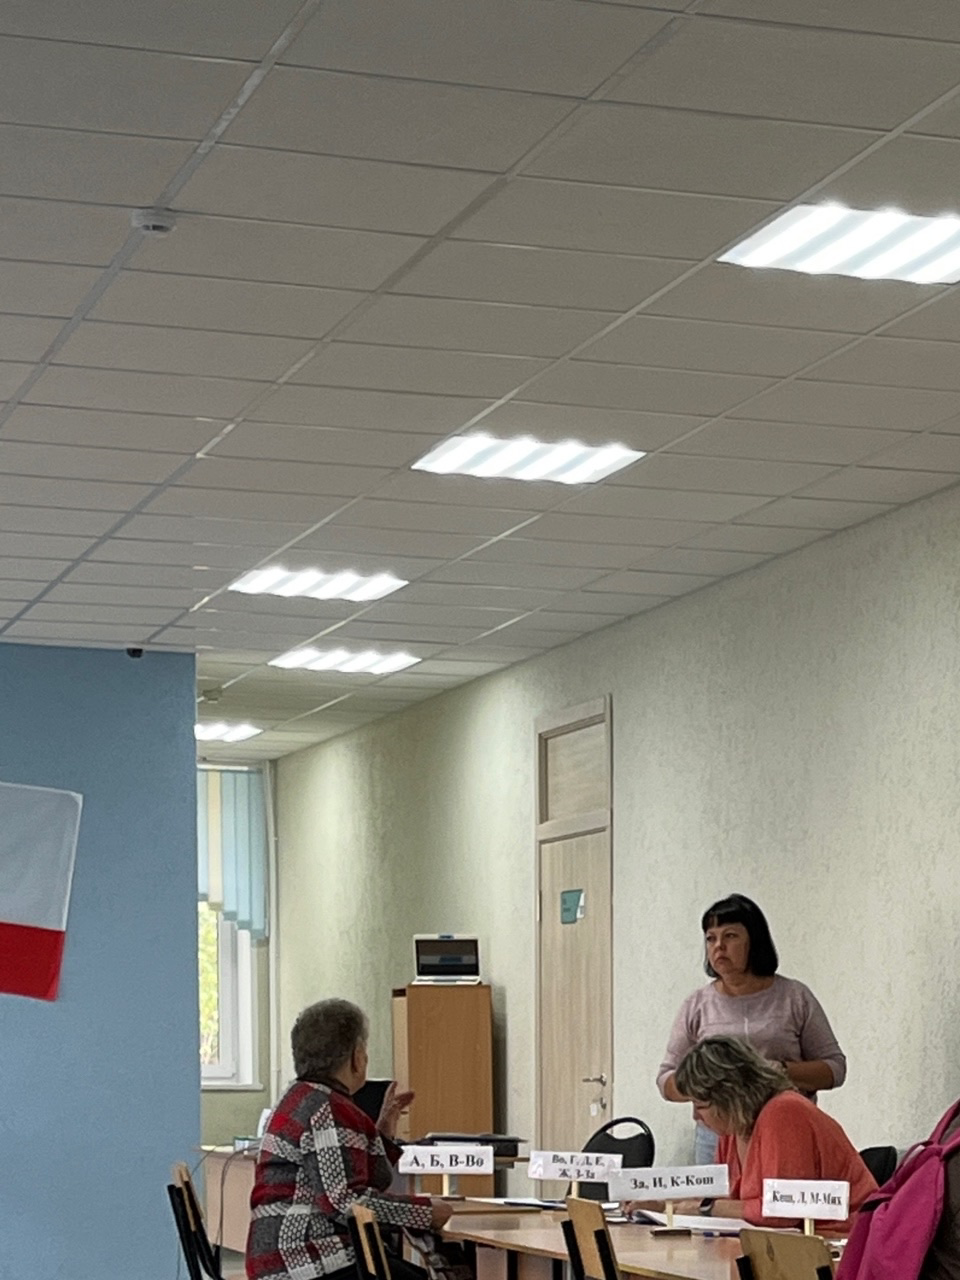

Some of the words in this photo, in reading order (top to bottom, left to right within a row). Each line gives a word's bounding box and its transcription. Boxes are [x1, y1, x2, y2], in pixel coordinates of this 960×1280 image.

[409, 1154, 425, 1169] А,
[430, 1153, 445, 1168] Б,
[449, 1153, 484, 1168] В-Во
[630, 1177, 650, 1190] За,
[652, 1176, 668, 1189] И,
[670, 1174, 715, 1187] К-Кош
